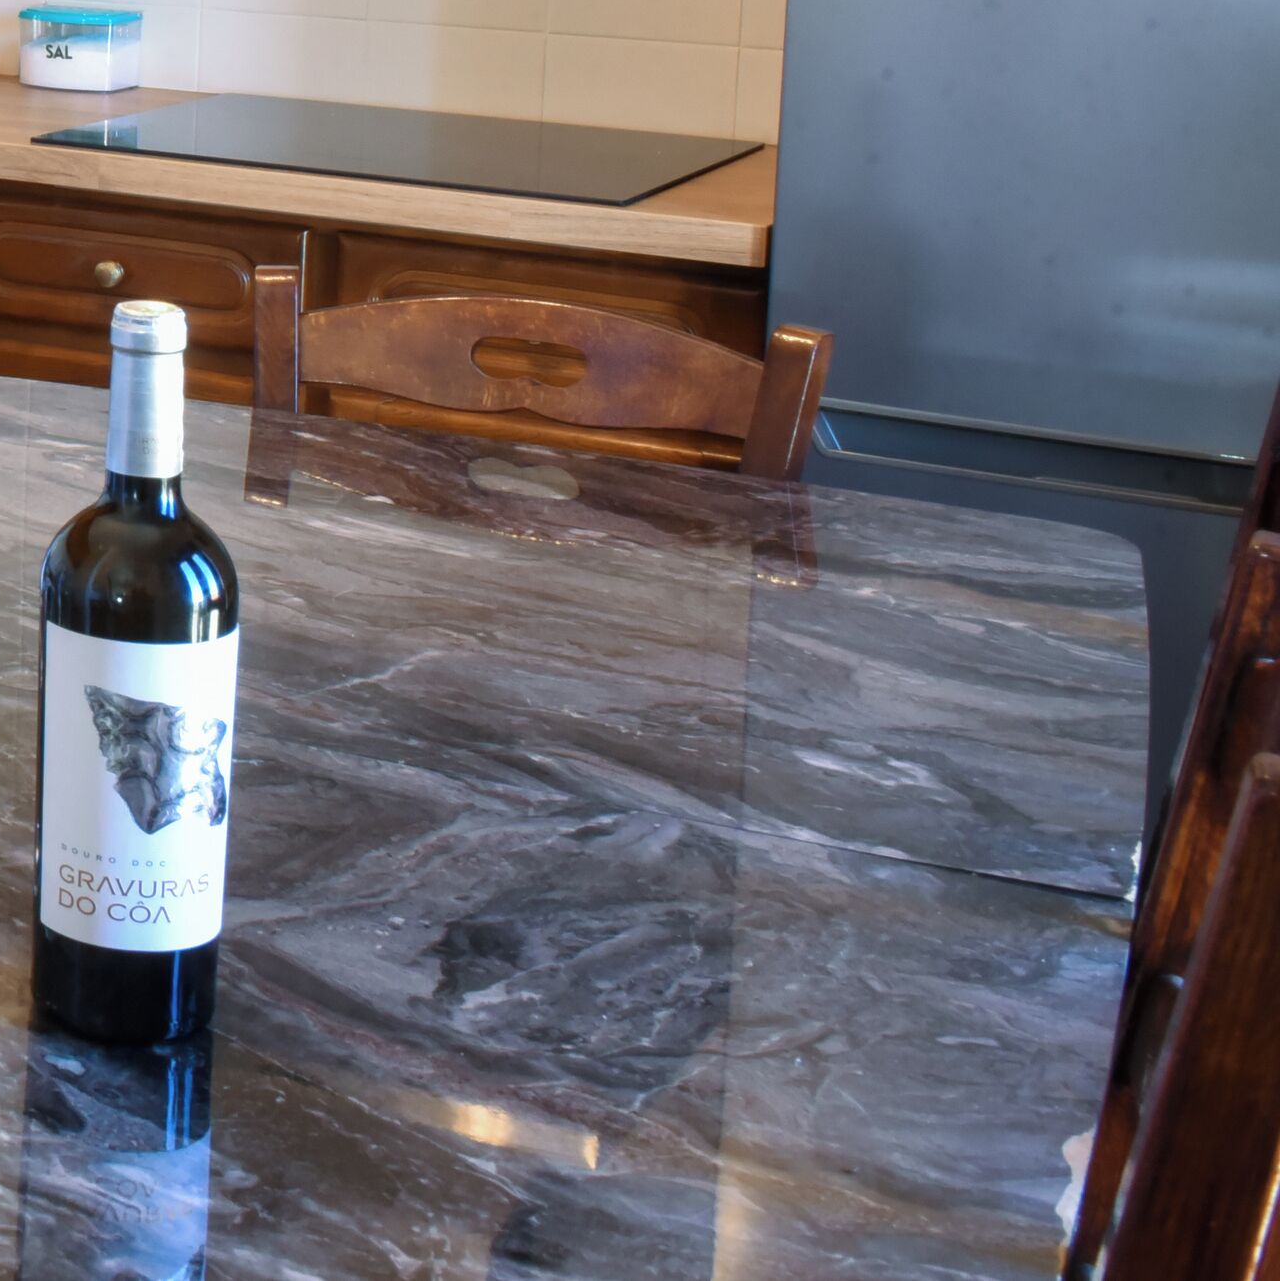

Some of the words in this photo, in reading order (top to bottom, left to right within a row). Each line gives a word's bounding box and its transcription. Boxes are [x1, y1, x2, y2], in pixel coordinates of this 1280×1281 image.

[45, 44, 73, 60] SAL
[61, 843, 117, 864] DOURO
[131, 859, 167, 867] DOC
[59, 864, 209, 899] GRAVURAS
[58, 887, 97, 916] DO
[107, 900, 171, 924] CÔA
